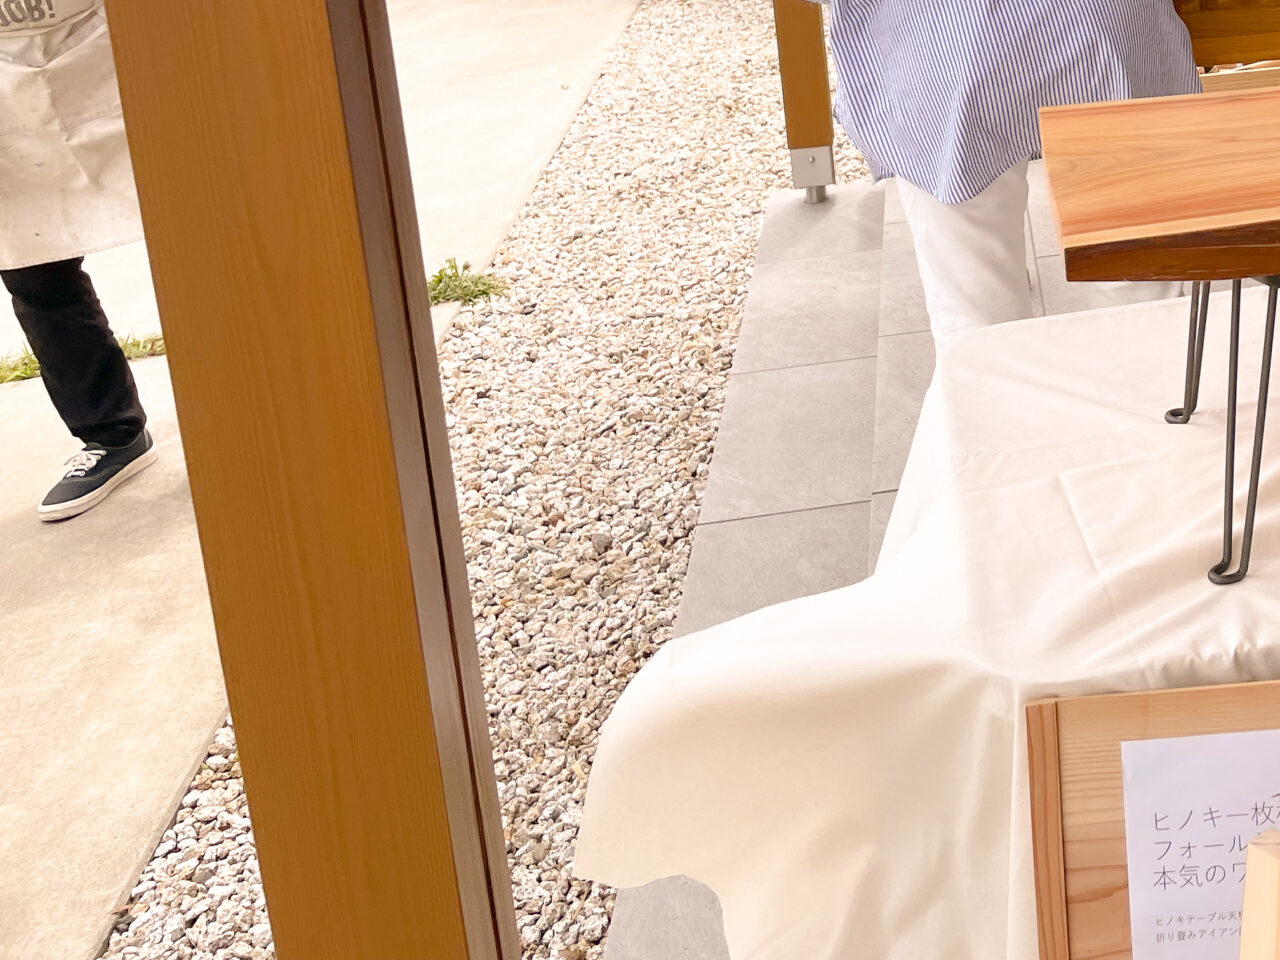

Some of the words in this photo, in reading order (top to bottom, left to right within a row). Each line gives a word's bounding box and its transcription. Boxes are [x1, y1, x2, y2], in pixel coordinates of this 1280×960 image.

[1154, 834, 1249, 861] フォール
[1156, 926, 1242, 943] 折り畳みアイアン
